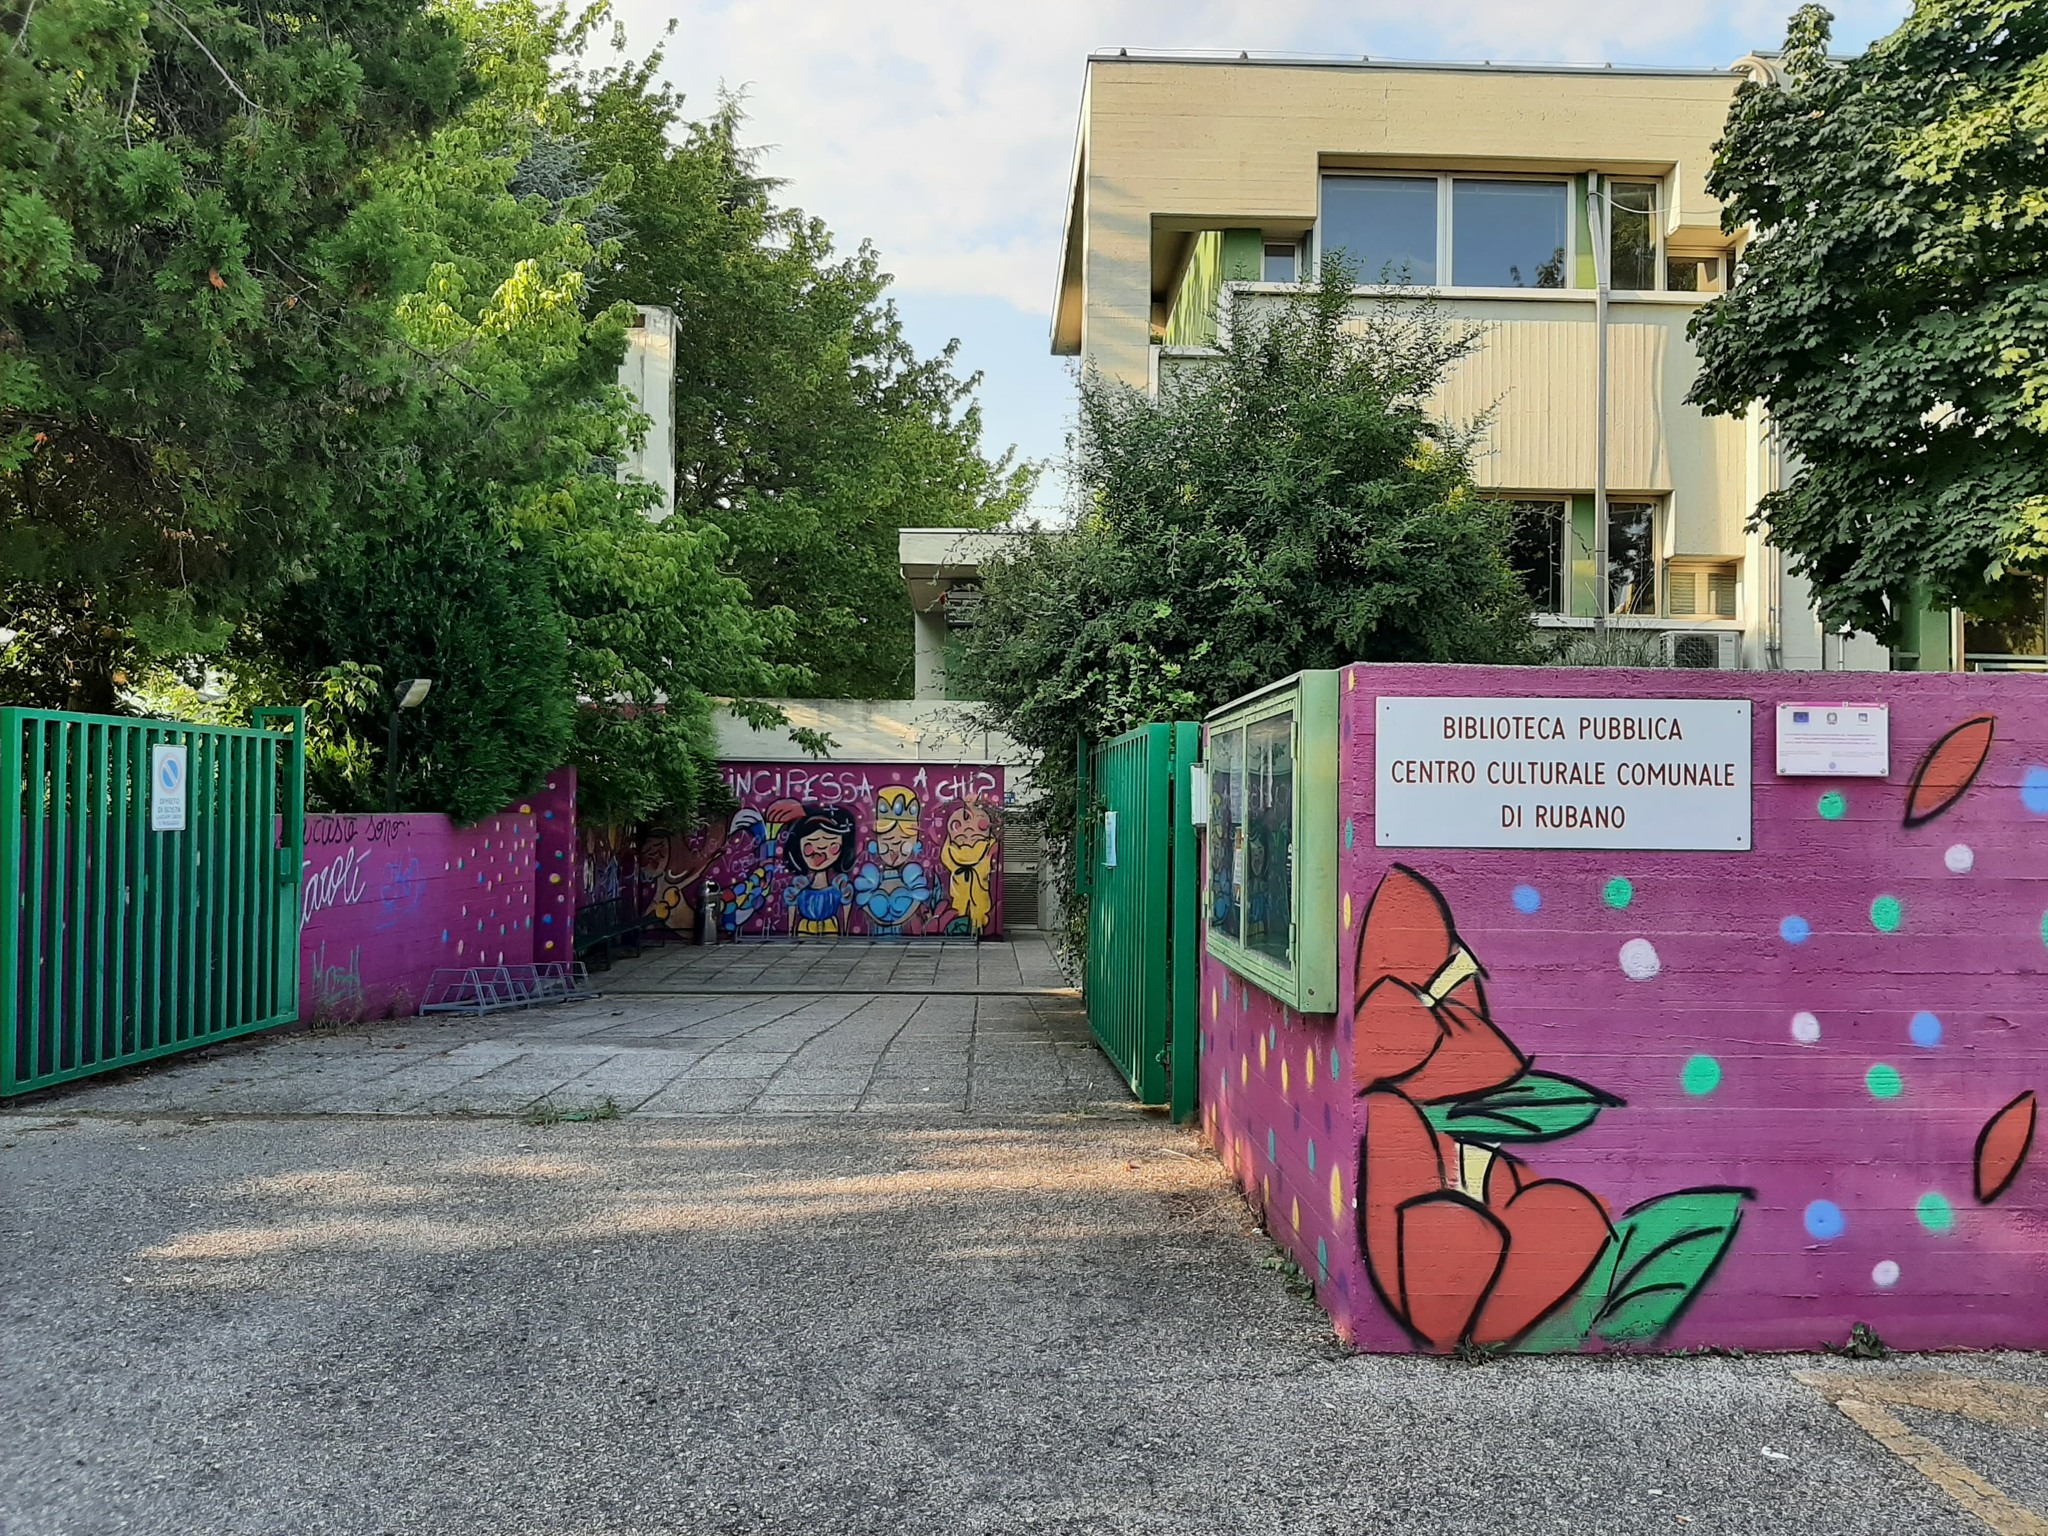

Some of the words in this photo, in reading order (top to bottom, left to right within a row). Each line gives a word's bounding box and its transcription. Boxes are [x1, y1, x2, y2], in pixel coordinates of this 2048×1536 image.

[1443, 716, 1566, 740] BIBLIOTECA
[1579, 717, 1683, 741] PUBBLICA
[913, 767, 929, 790] A
[1391, 760, 1476, 784] CENTRO
[1487, 761, 1606, 786] CULTURALE
[1616, 762, 1736, 787] COMUNALE
[1500, 805, 1522, 828] DI
[1535, 805, 1626, 829] RUBANO
